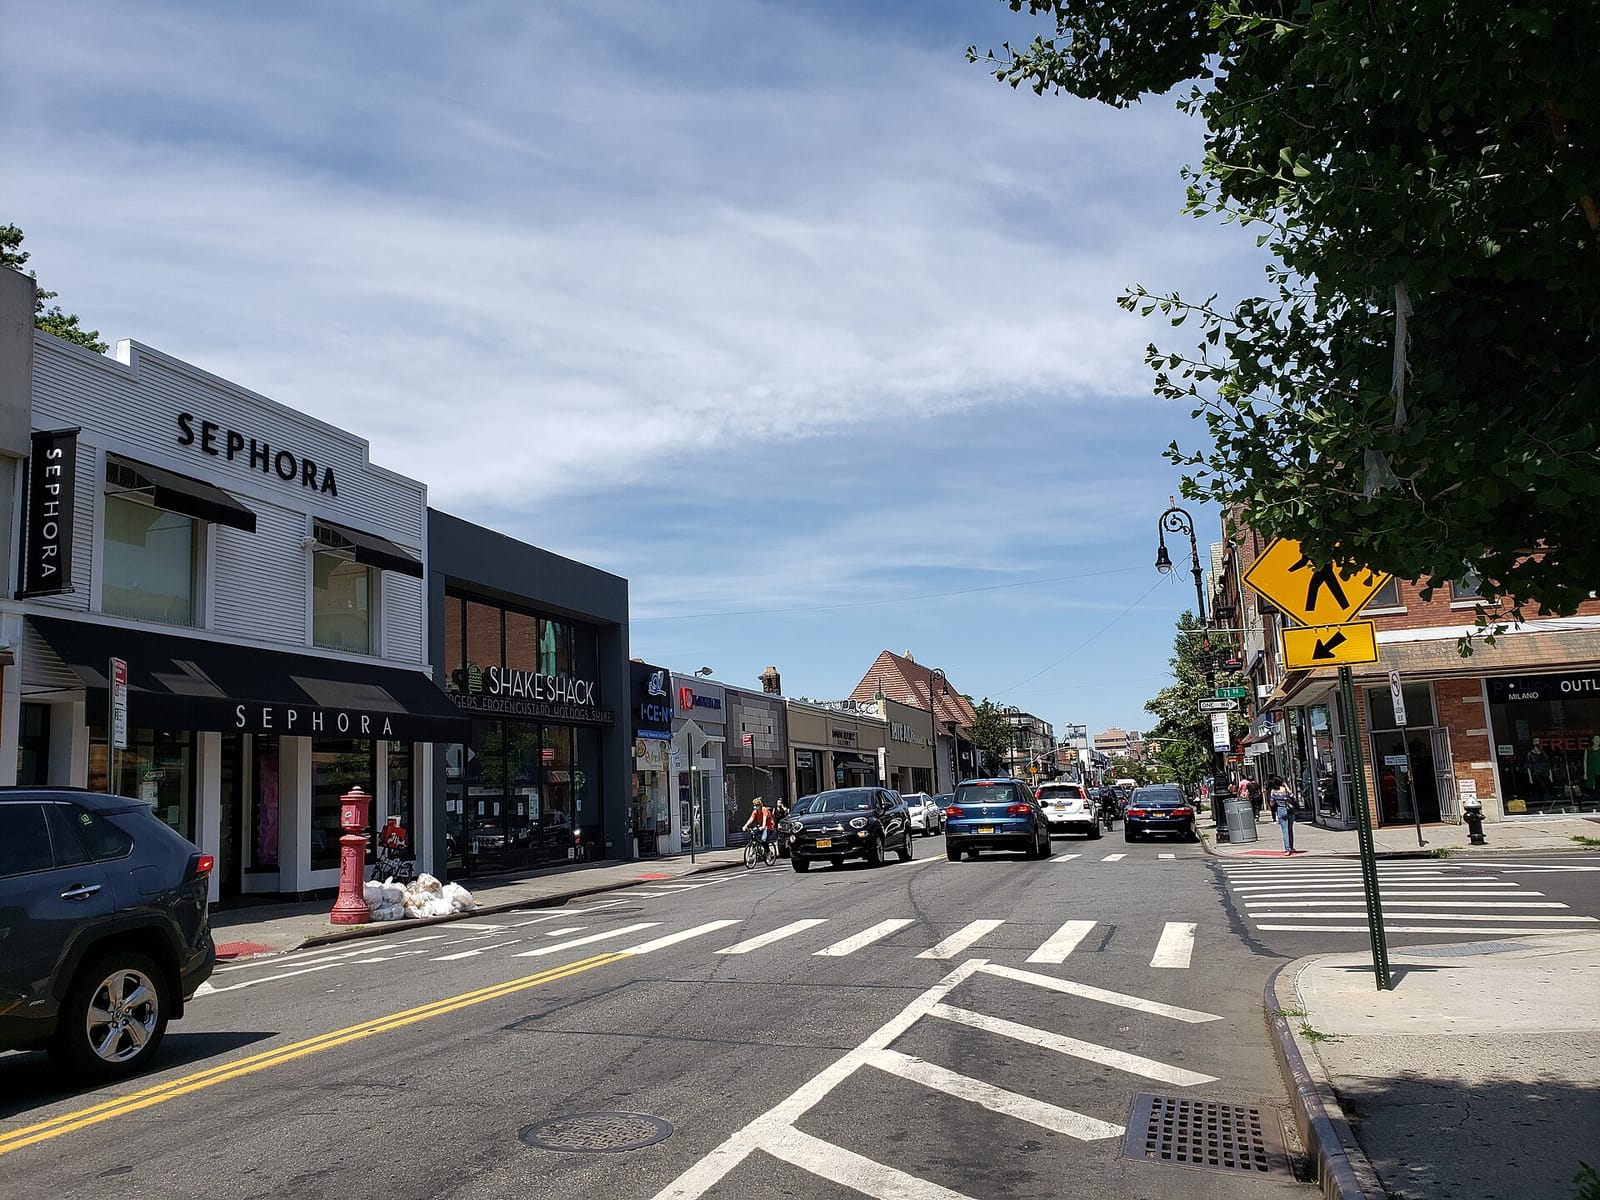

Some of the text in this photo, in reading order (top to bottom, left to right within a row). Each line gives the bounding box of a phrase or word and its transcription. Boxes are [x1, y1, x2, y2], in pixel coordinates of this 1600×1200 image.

[177, 412, 339, 497] SEPHORA
[41, 448, 62, 578] SEPHORA
[489, 665, 595, 706] SHAKE SHACK
[1508, 691, 1539, 700] MILANO
[236, 704, 393, 736] SEPHORA
[516, 703, 550, 717] CUSTARD
[1540, 737, 1589, 751] FREE
